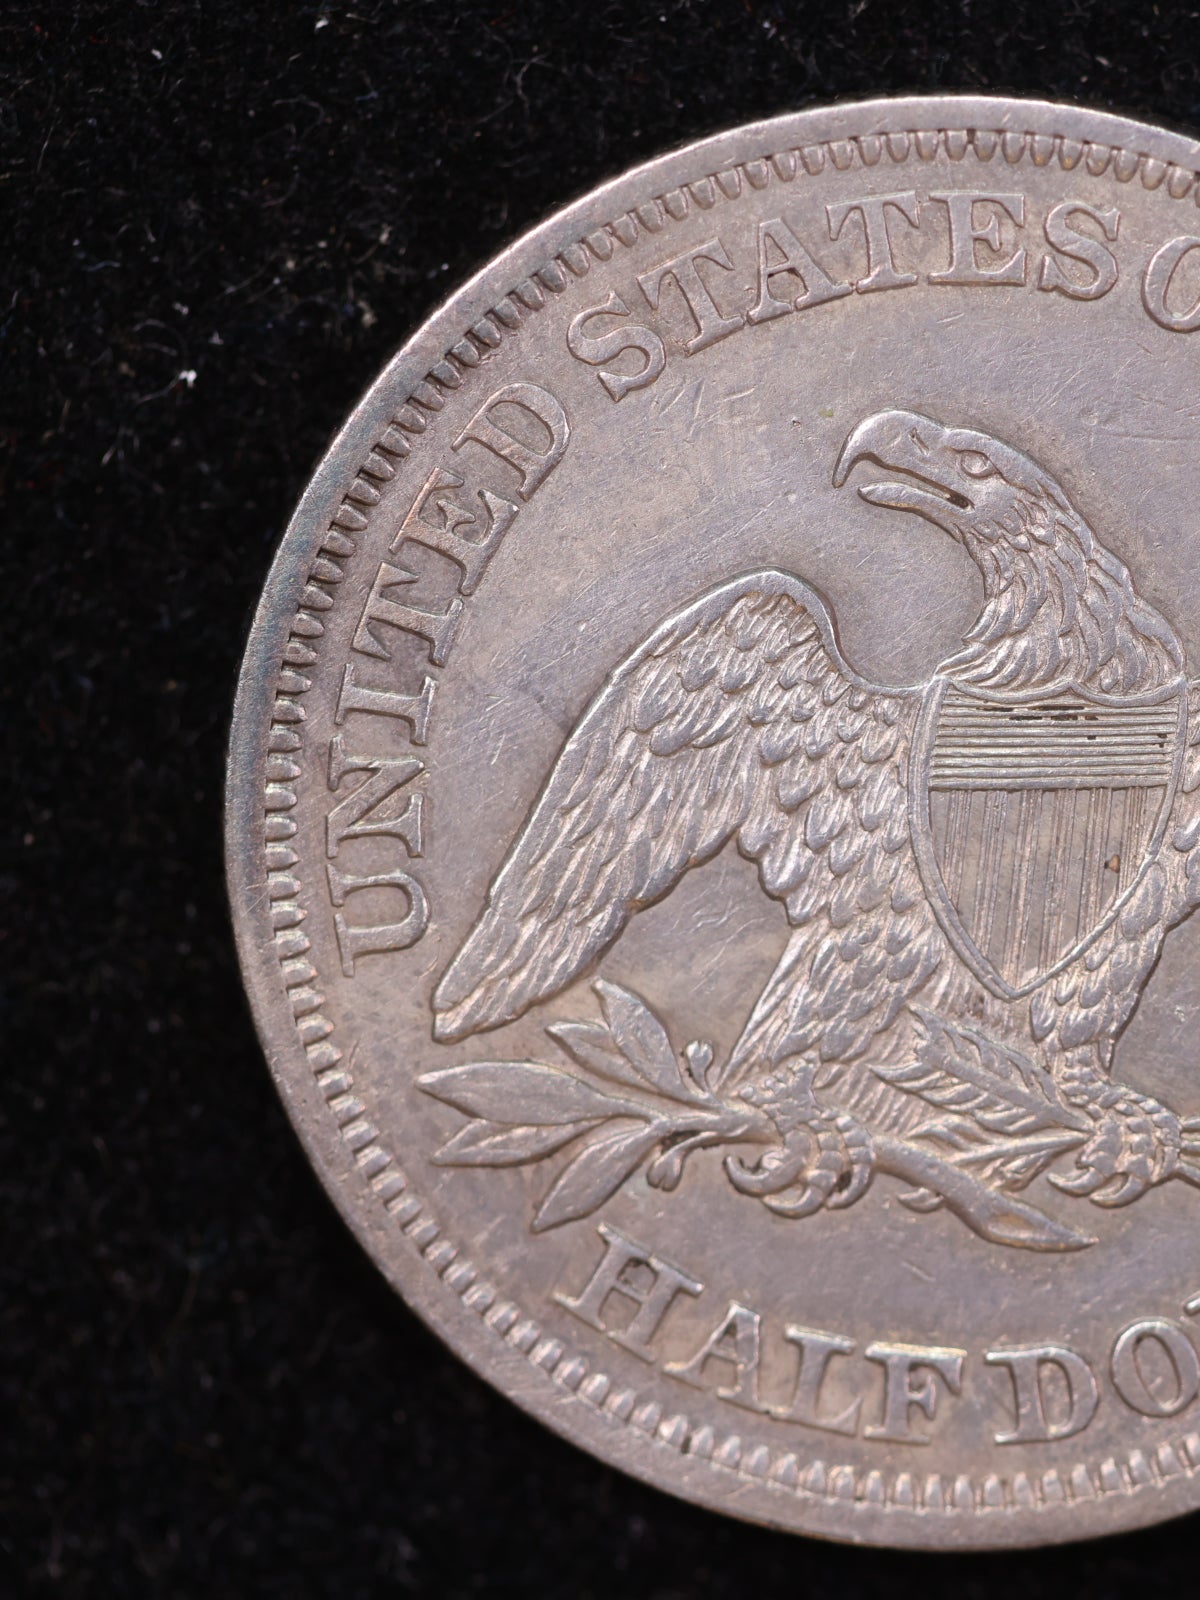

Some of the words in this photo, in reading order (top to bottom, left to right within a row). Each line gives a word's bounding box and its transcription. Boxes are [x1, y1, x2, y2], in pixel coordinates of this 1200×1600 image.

[326, 382, 572, 978] UNITED
[566, 189, 1121, 403] STATES
[555, 1222, 967, 1446] HALF
